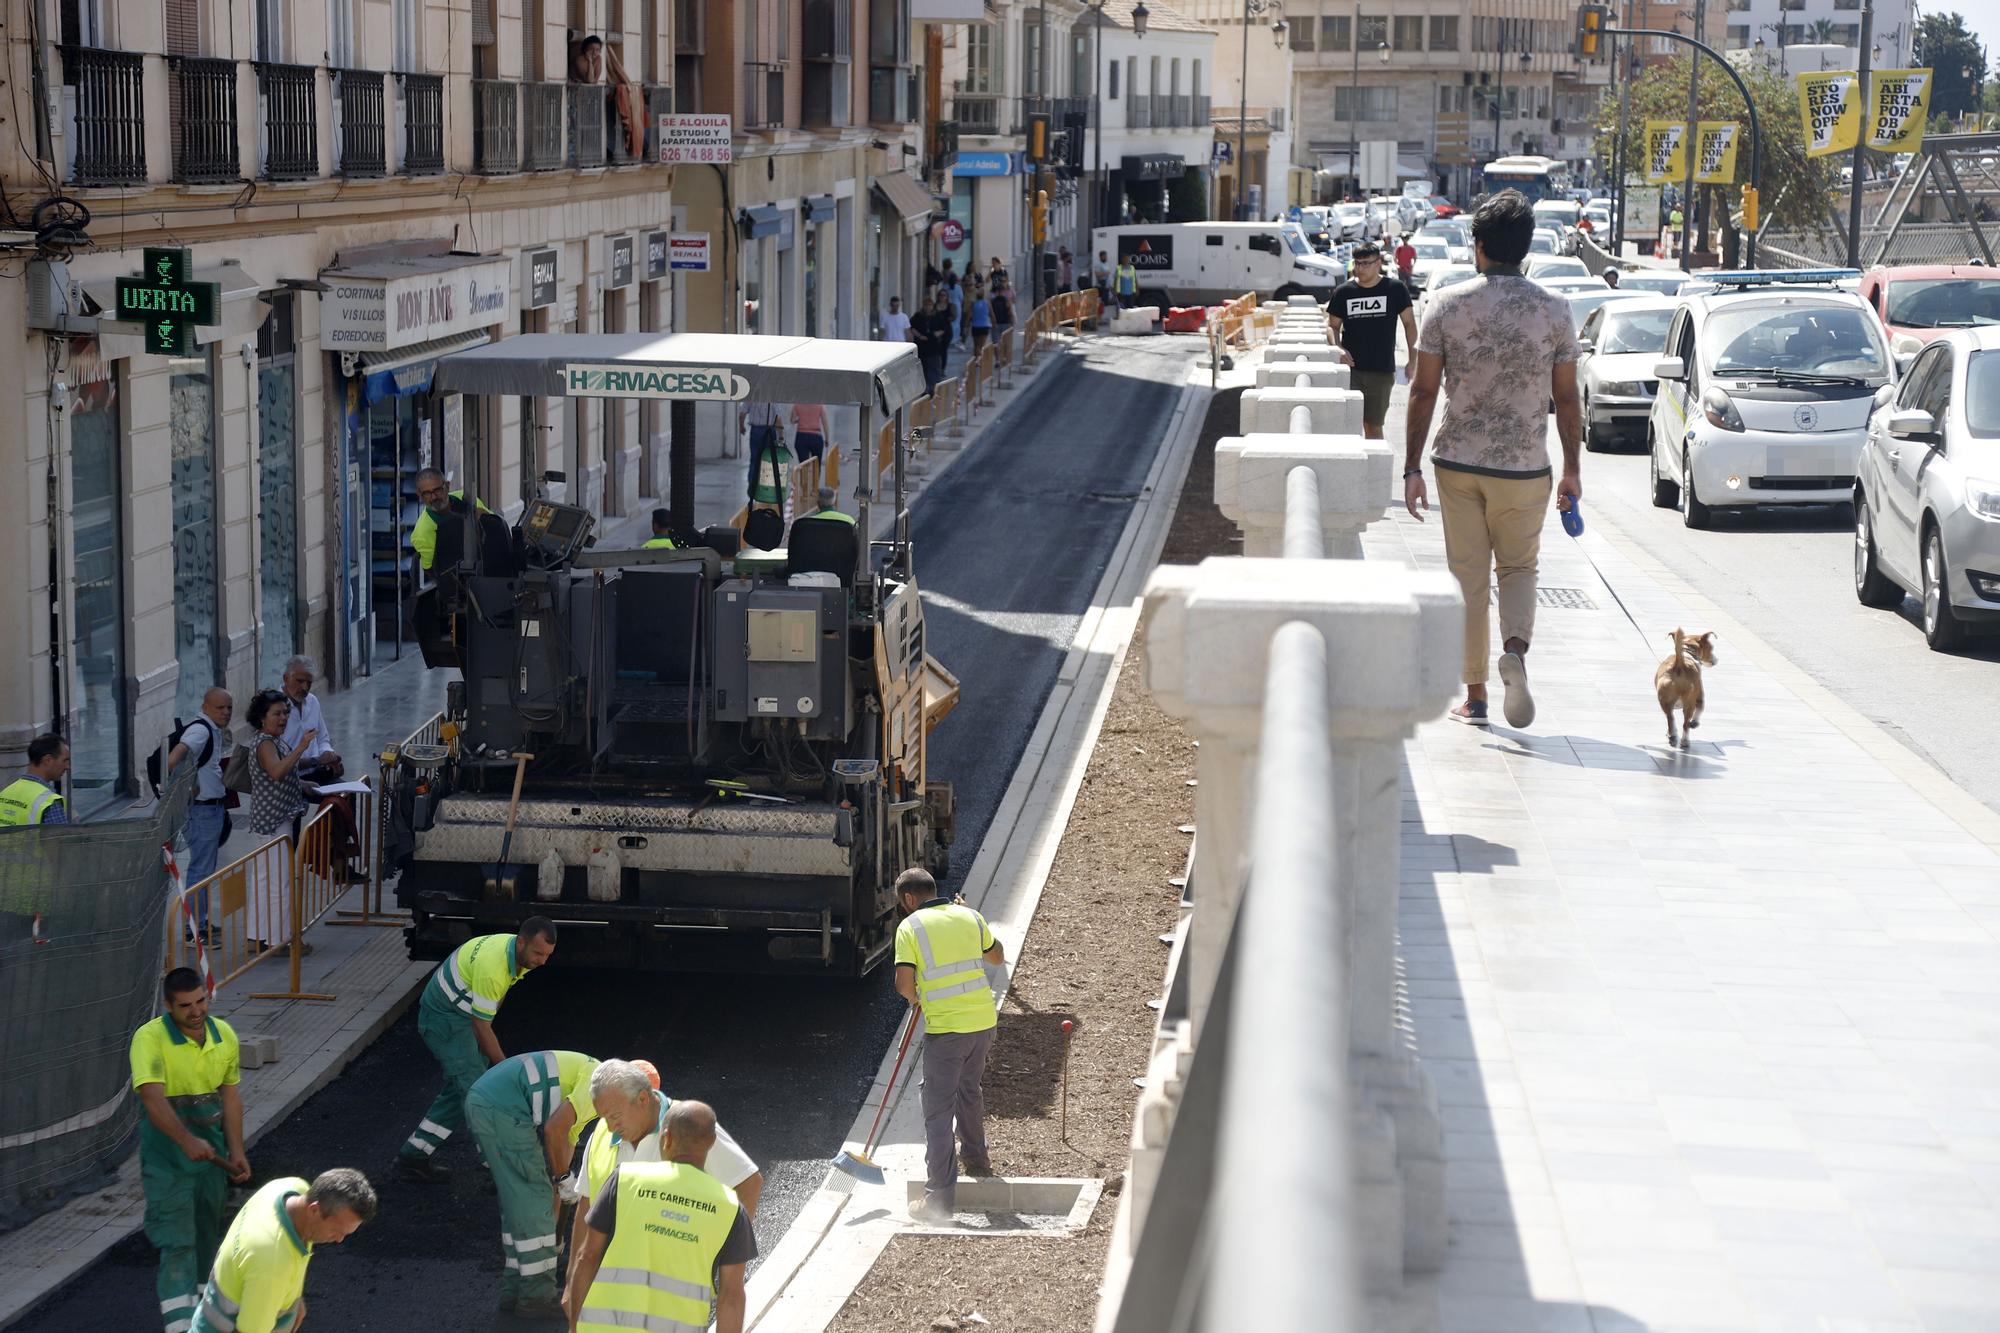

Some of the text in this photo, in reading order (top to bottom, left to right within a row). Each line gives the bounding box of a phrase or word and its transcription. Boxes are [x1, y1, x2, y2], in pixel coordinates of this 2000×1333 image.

[1807, 84, 1839, 96] STO
[1880, 84, 1908, 94] ABI
[1808, 94, 1839, 106] RES
[1880, 95, 1922, 107] ERTA
[1810, 104, 1847, 117] NOW
[1880, 106, 1910, 117] POR
[662, 118, 728, 127] SE ALQUILA
[1811, 116, 1839, 129] OPE
[1878, 117, 1898, 128] OB
[1814, 129, 1824, 140] N
[1876, 129, 1908, 140] RAS
[1218, 142, 1228, 157] P
[1651, 141, 1680, 149] ERTA
[1701, 141, 1731, 149] ERTA
[661, 147, 730, 160] 626 74 88 56
[1651, 149, 1671, 157] POR
[1701, 149, 1722, 157] POR
[1651, 157, 1664, 165] OB
[1701, 157, 1715, 165] OB
[1652, 165, 1673, 173] RAS
[1700, 164, 1722, 173] RAS
[1128, 253, 1169, 266] OOMIS
[123, 287, 195, 312] UERTA
[336, 287, 386, 301] CORTINAS
[1351, 299, 1382, 311] FILA
[342, 309, 386, 322] VISILLOS
[332, 329, 386, 343] EDREDONES
[570, 369, 727, 395] HORMACESA
[638, 1188, 717, 1214] UTE CARRETERÍA
